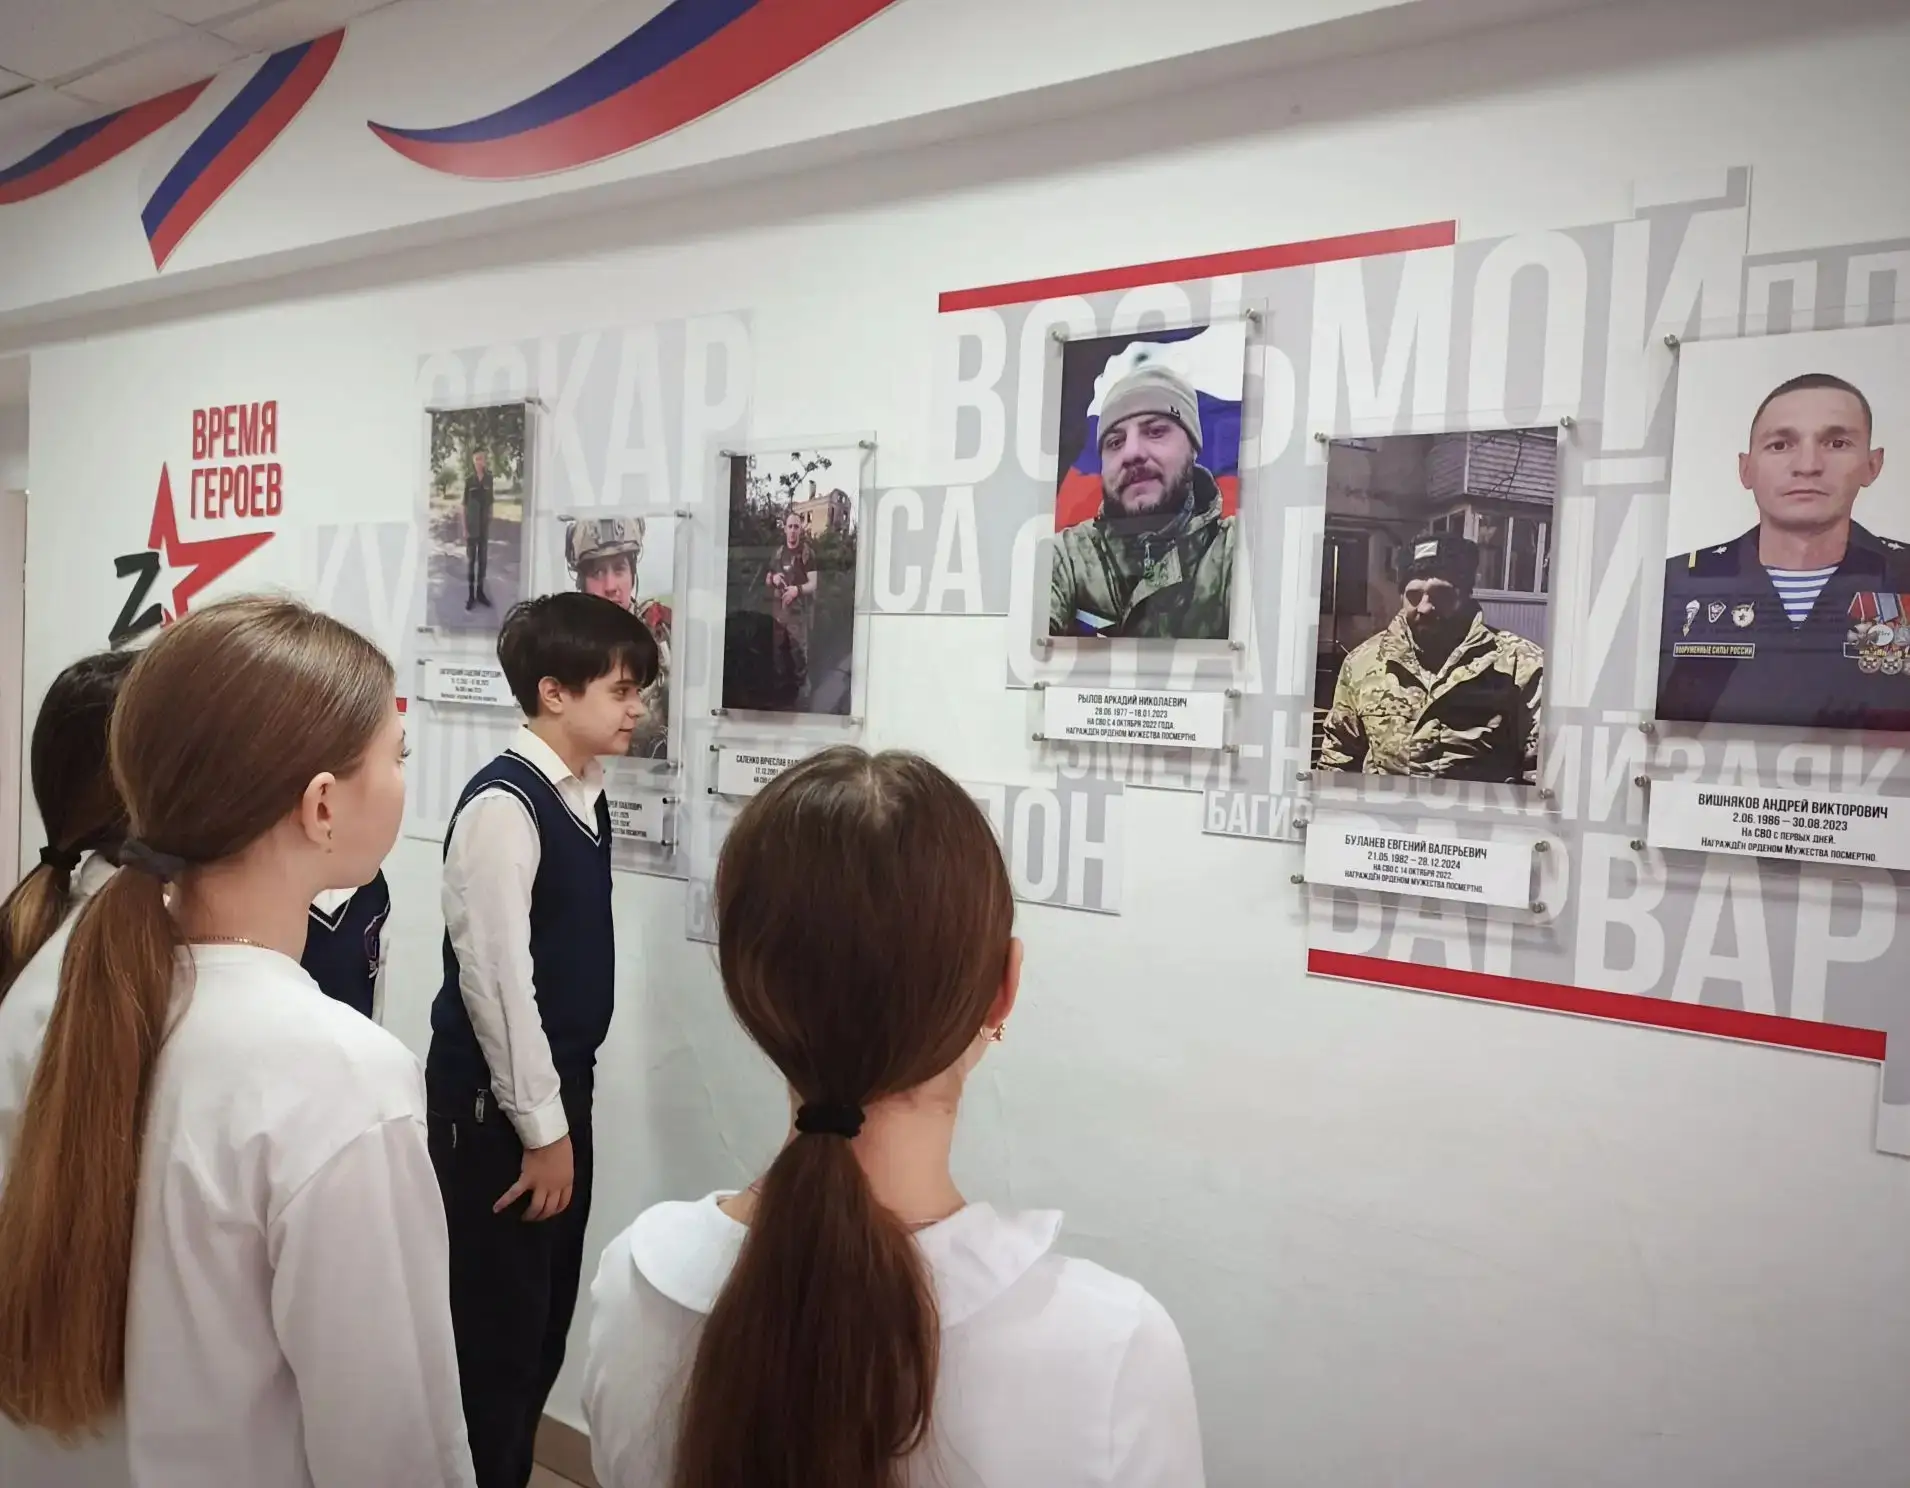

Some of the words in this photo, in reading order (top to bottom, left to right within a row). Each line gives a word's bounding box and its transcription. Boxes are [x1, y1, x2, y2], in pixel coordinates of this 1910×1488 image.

[192, 400, 277, 460] ВРЕМЯ
[190, 462, 283, 520] ГЕРОЕВ
[108, 551, 163, 650] Z
[1712, 646, 1729, 655] СИЛЫ
[1730, 646, 1753, 655] РОССИИ
[1077, 694, 1103, 704] РЫЛОВ
[1104, 694, 1137, 706] АРКАДИЙ
[1139, 696, 1188, 708] НИКОЛАЕВИЧ
[1116, 719, 1142, 728] ОКТЯБРЯ
[1142, 721, 1157, 729] 2022
[1100, 728, 1127, 738] ОРДЕНОМ
[1128, 730, 1160, 740] МУЖЕСТВА
[1698, 793, 1760, 810] ВИШНЯКОВ
[1762, 798, 1808, 814] АНДРЕЙ
[1811, 802, 1888, 819] ВИКТОРОВИЧ
[1732, 812, 1780, 827] 2.06.1986
[1792, 817, 1848, 831] 30.08.2023
[1754, 828, 1772, 839] СВО
[1345, 834, 1386, 849] БУЛАНЕВ
[1387, 839, 1426, 853] ЕВГЕНИЙ
[1428, 844, 1488, 860] ВАЛЕРЬЕВИЧ
[1367, 851, 1409, 864] 21.05.1982
[1418, 856, 1461, 870] 28.12.2024
[1373, 863, 1381, 871] НА
[1382, 864, 1393, 873] СВО
[1400, 866, 1408, 874] 14
[1408, 867, 1435, 878] ОКТЯБРЯ
[1381, 874, 1410, 885] ОРДЕНОМ
[1411, 877, 1445, 889] МУЖЕСТВА
